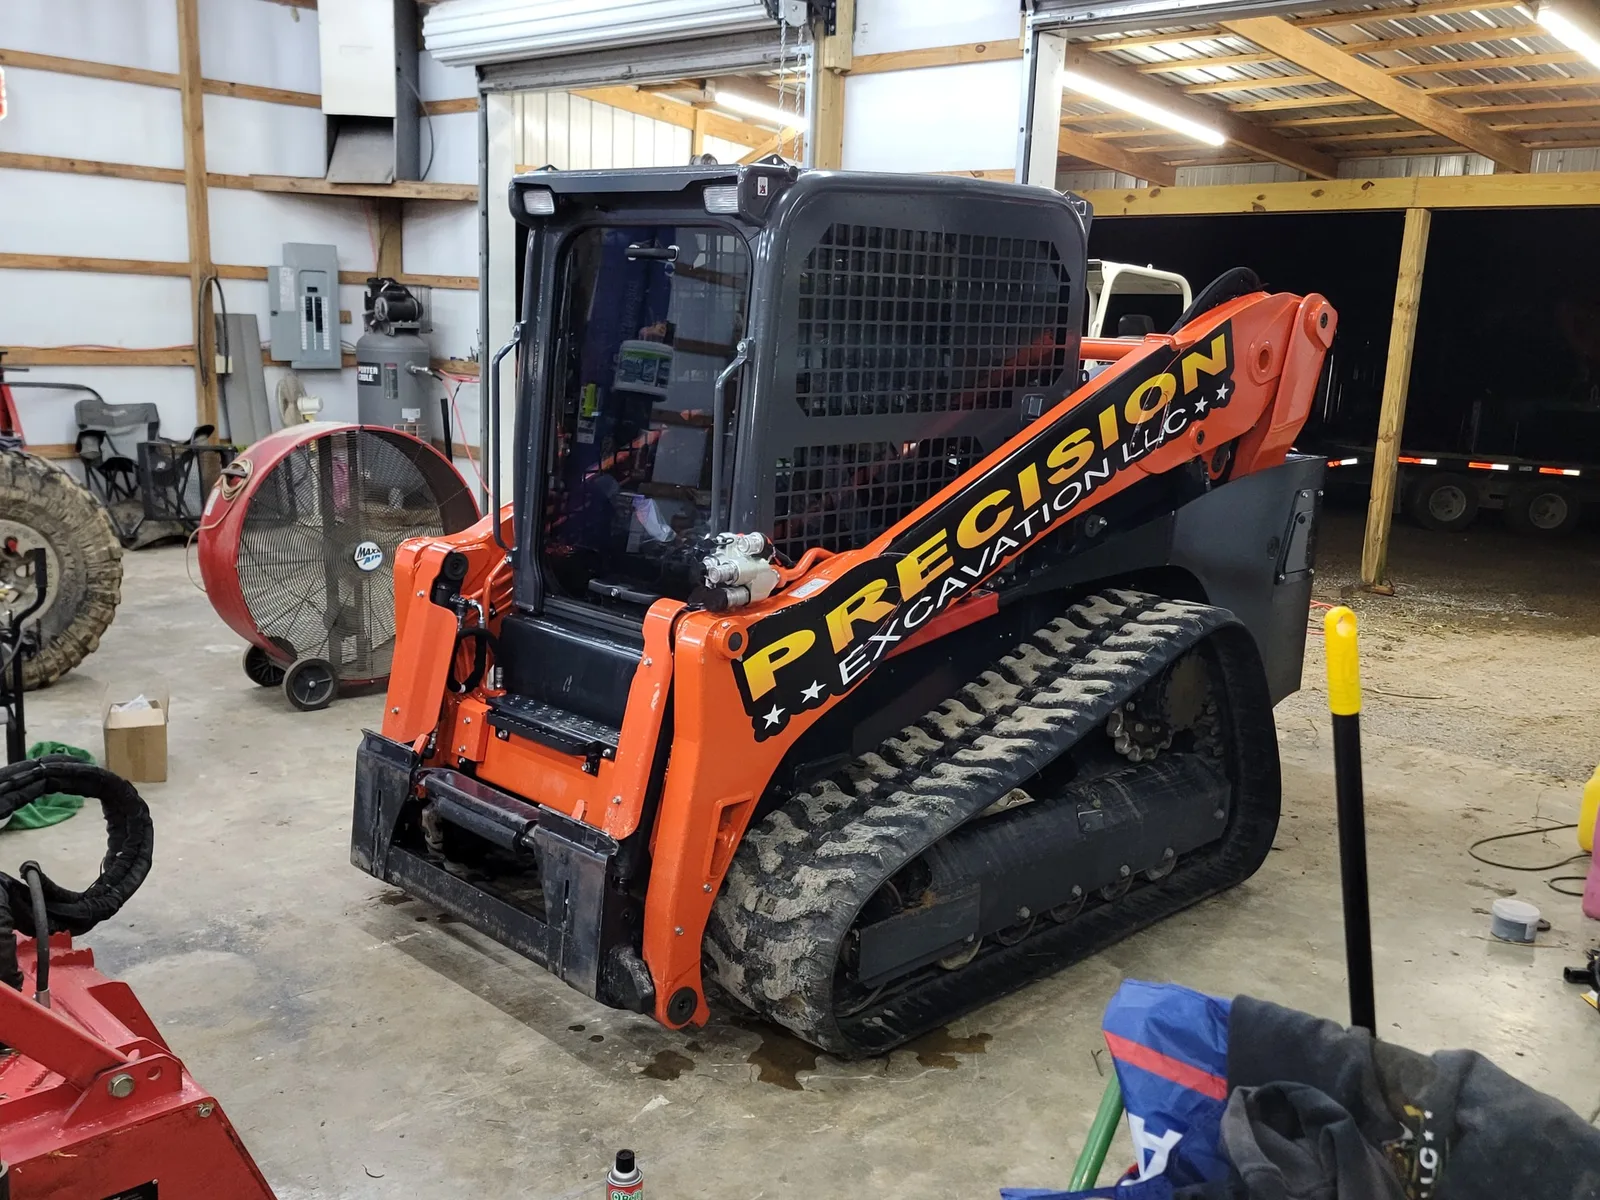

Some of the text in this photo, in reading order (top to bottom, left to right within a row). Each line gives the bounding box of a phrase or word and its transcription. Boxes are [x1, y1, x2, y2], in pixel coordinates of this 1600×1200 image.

[743, 333, 1227, 702] PRECISION
[838, 408, 1188, 686] EXCAVATION LLC
